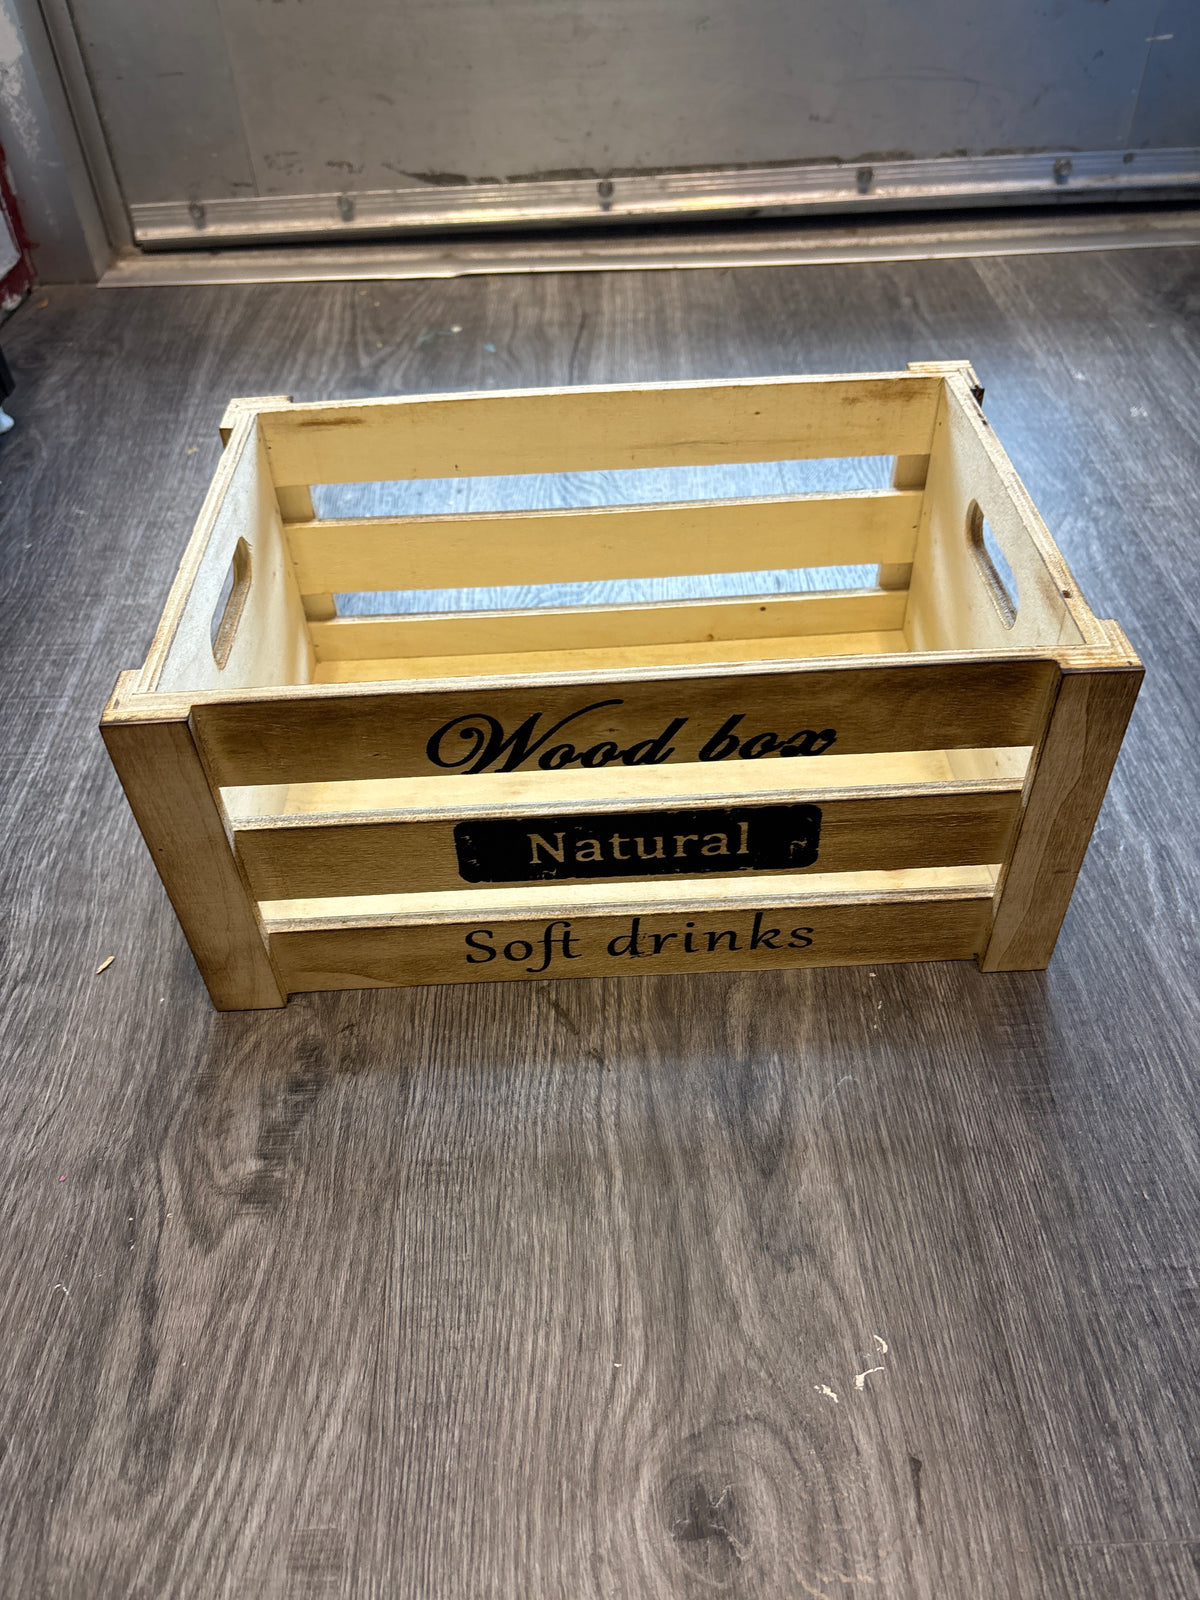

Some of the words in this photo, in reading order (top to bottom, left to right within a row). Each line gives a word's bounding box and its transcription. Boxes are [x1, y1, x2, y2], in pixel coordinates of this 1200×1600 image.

[426, 699, 689, 774] Wood
[699, 713, 837, 762] box
[527, 822, 750, 864] Natural
[465, 921, 582, 972] Soft
[607, 912, 815, 958] drinks
